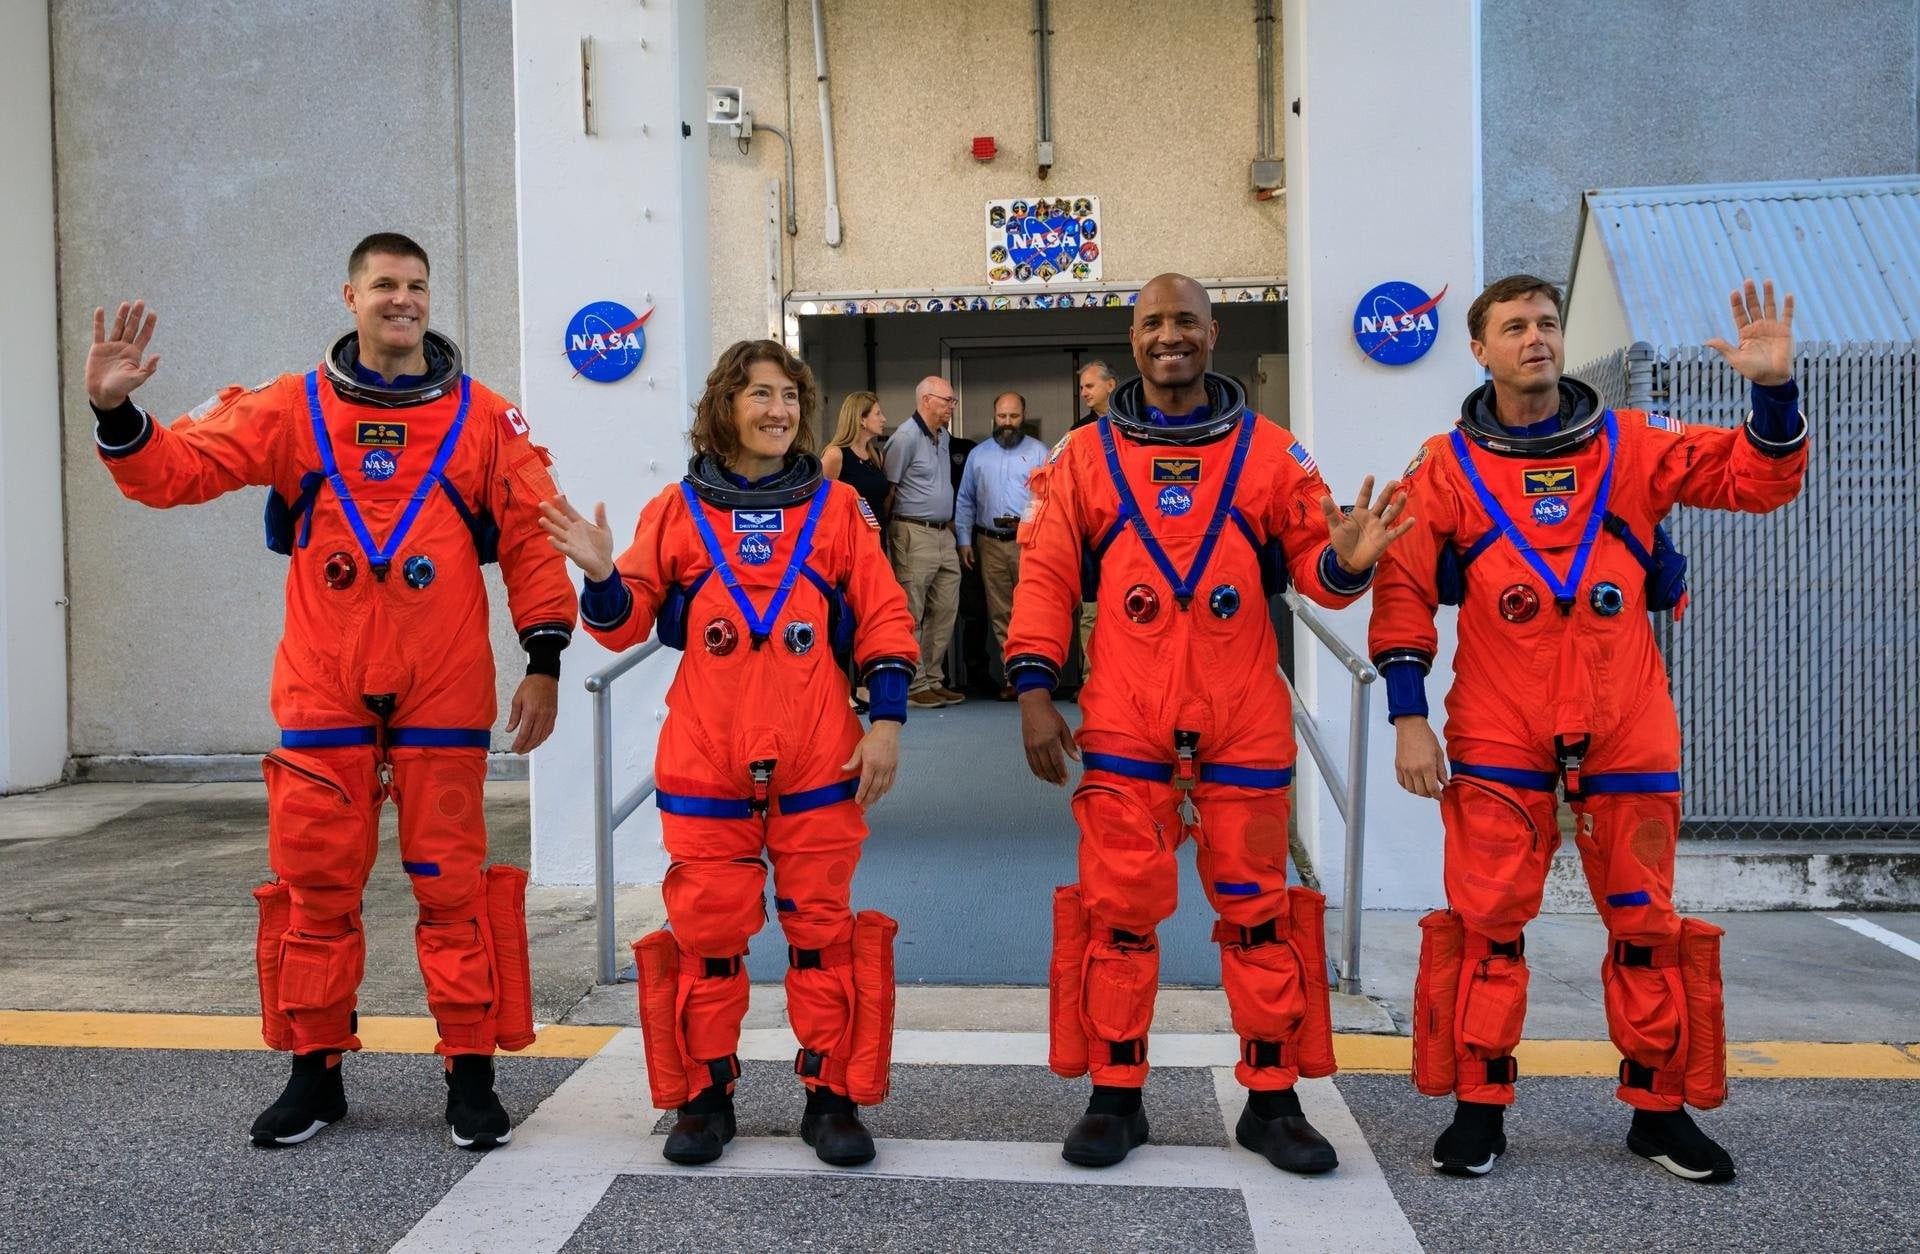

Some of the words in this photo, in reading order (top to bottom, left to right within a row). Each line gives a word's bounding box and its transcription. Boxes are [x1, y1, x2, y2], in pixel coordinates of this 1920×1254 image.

[1013, 232, 1077, 249] NASA
[1360, 313, 1434, 333] NASA
[571, 333, 641, 351] NASA
[365, 460, 395, 469] NASA
[1160, 496, 1191, 506] NASA
[1534, 504, 1568, 515] NASA
[741, 544, 772, 553] NASA
